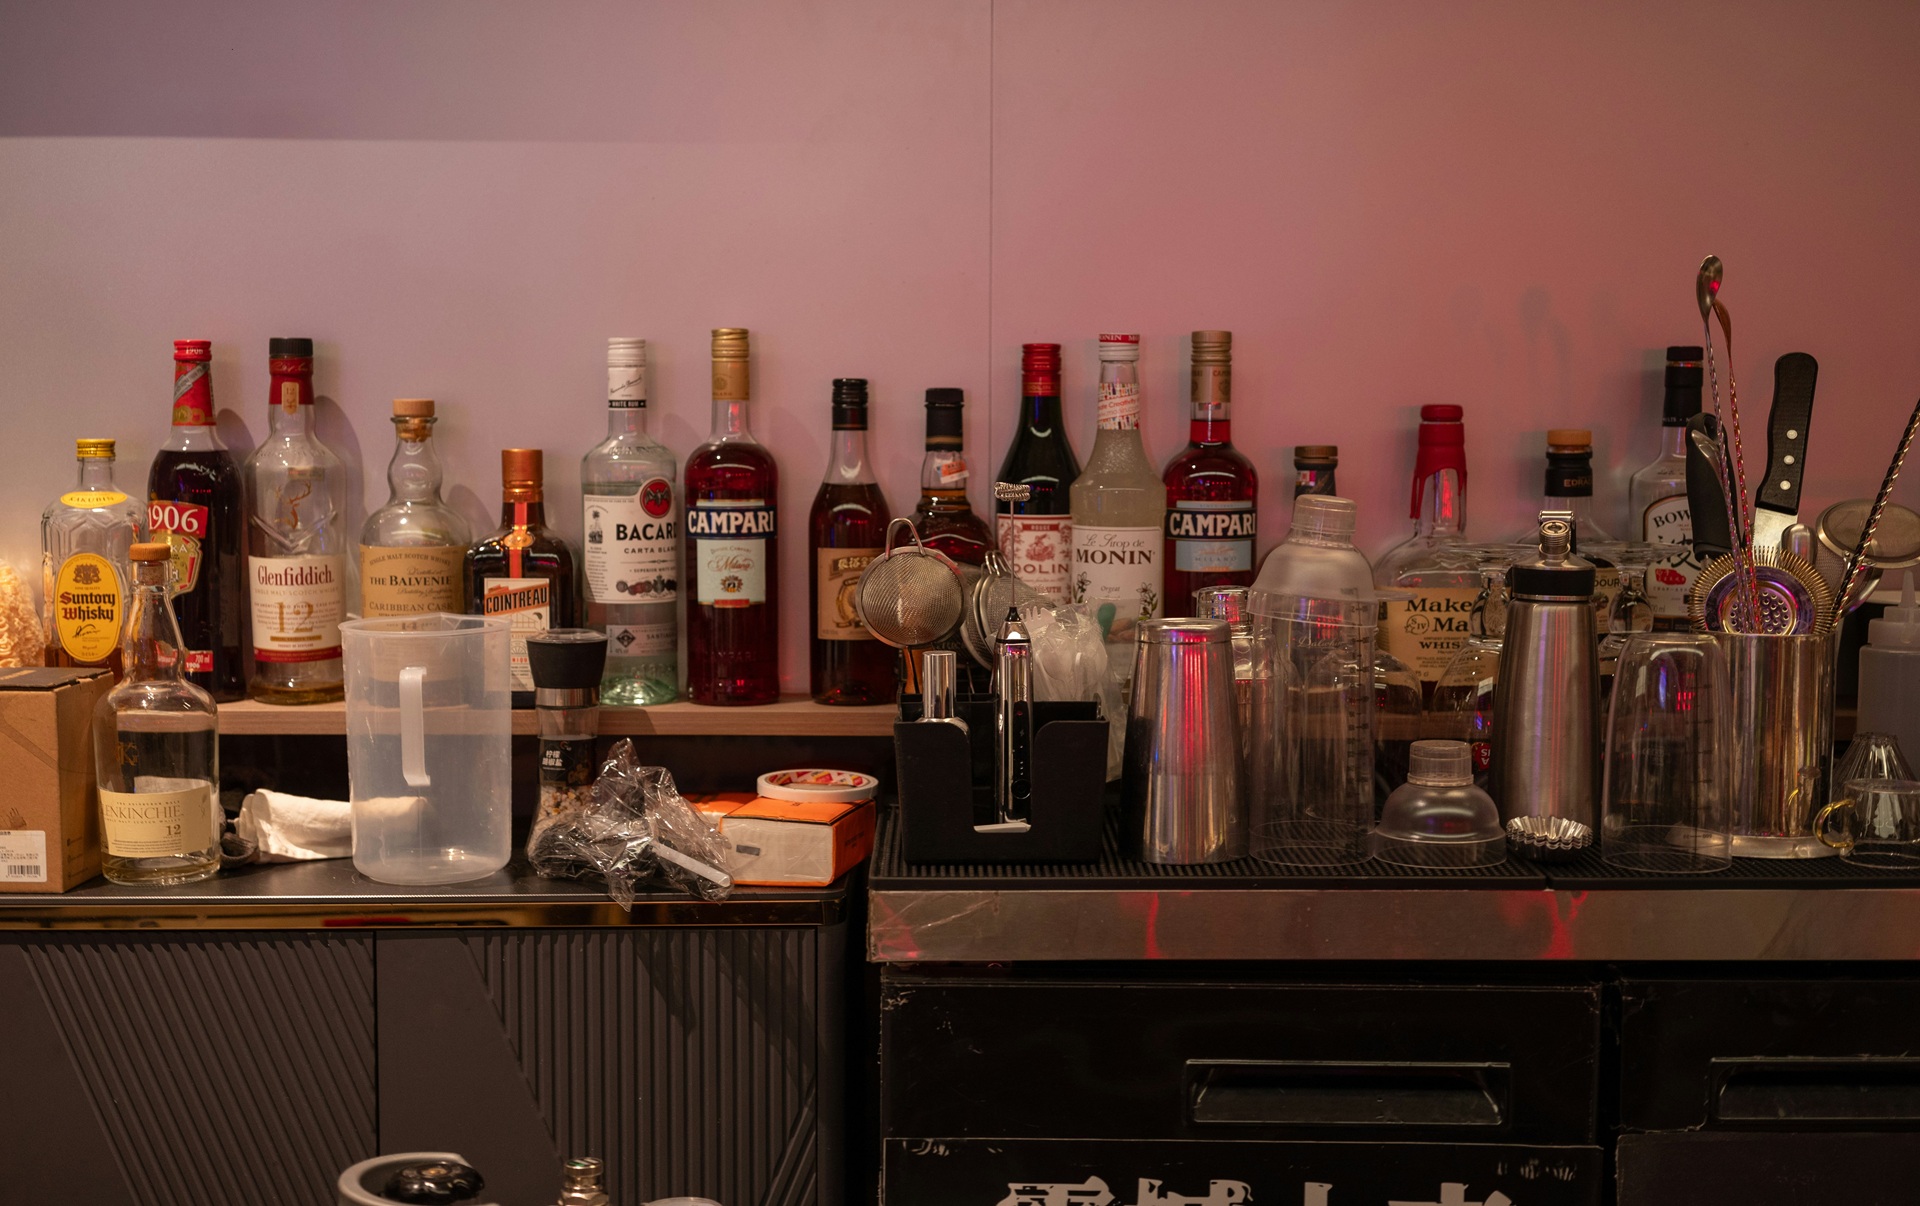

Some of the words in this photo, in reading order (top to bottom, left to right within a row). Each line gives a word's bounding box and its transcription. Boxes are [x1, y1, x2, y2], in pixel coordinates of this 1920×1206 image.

[148, 504, 199, 533] 1906
[687, 510, 774, 534] CAMPARI
[1169, 512, 1256, 537] CAMPARI
[1082, 533, 1098, 547] Le
[1132, 539, 1145, 548] de
[1076, 547, 1153, 565] MONIN
[257, 564, 332, 586] Glenfiddich
[1012, 563, 1069, 574] DOLIN
[370, 577, 387, 586] THE
[59, 591, 116, 607] Suntory
[369, 601, 425, 612] CARIBBEAN
[427, 602, 454, 612] CASK
[485, 586, 548, 614] COINTREAU
[1404, 597, 1473, 613] Make
[61, 605, 114, 623] Whisky
[1431, 616, 1469, 632] Ma
[1418, 641, 1461, 650] WHIS
[104, 804, 181, 820] ENKINCHIE
[165, 823, 182, 836] 12
